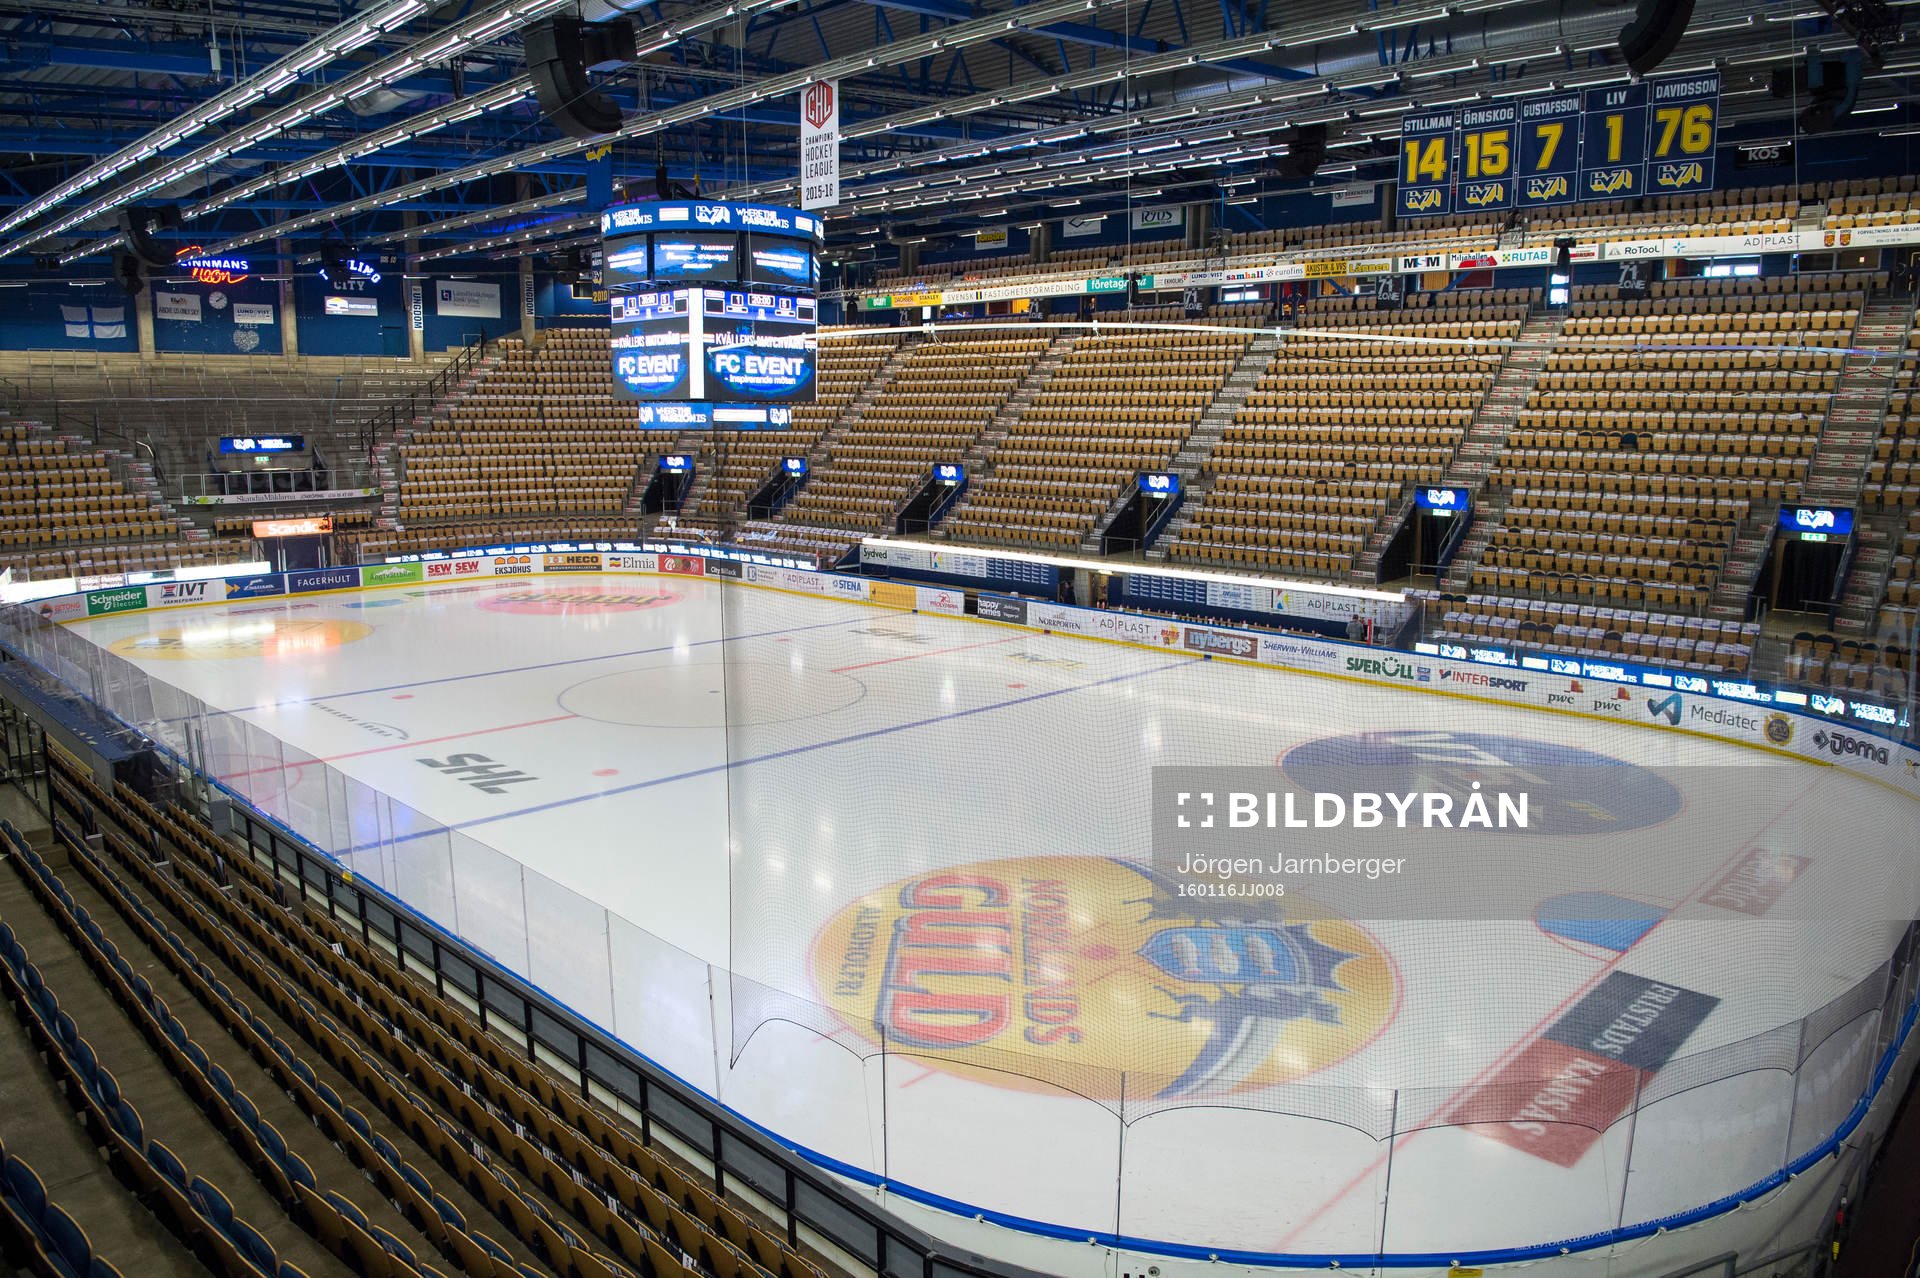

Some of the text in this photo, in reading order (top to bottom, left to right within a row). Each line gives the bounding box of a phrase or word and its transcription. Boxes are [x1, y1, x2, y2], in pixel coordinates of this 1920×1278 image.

[1655, 79, 1717, 99] DAVIDSSON
[1523, 97, 1579, 117] GUSTAFSSON
[1606, 91, 1627, 106] LIV
[1404, 116, 1453, 132] STILLMAN
[1463, 107, 1514, 125] ÖRNSKOG
[805, 132, 834, 146] CHAMPIONS
[1606, 114, 1624, 163] 1
[1655, 104, 1713, 158] 76
[805, 144, 834, 162] HOCKEY
[1464, 130, 1510, 179] 15
[1536, 122, 1563, 171] 7
[1405, 138, 1447, 183] 14
[805, 161, 834, 179] LEAGUE
[805, 184, 834, 201] 2015-16
[1511, 250, 1549, 262] RUTAB
[1226, 270, 1264, 282] samhall
[1274, 266, 1304, 277] eurofins
[333, 280, 366, 291] CITY
[525, 281, 535, 316] UNGDOM
[592, 290, 608, 303] 2010
[947, 293, 974, 302] SVENSK
[412, 292, 423, 329] UNGDOM
[618, 354, 681, 375] FC EVENT
[715, 354, 805, 376] FC EVENT
[566, 555, 599, 564] HECO
[863, 546, 888, 561] Sydved
[427, 563, 452, 574] SEW
[455, 560, 480, 572] SEW
[622, 556, 656, 569] Elmia
[178, 581, 209, 597] IVT
[297, 574, 351, 588] FAGERHULT
[838, 578, 862, 592] STENA
[89, 591, 142, 606] Schneider
[1263, 640, 1337, 659] SHERWIN-WILLIAMS
[1452, 669, 1528, 692] INTERSPORT
[1548, 693, 1575, 705] pwc
[1593, 700, 1622, 712] pwc
[1691, 704, 1759, 732] Mediatec
[415, 753, 541, 795] SHL
[880, 875, 1013, 1050] GULD
[1592, 983, 1681, 1056] FRISTADS
[1508, 1056, 1609, 1137] KANSAS
